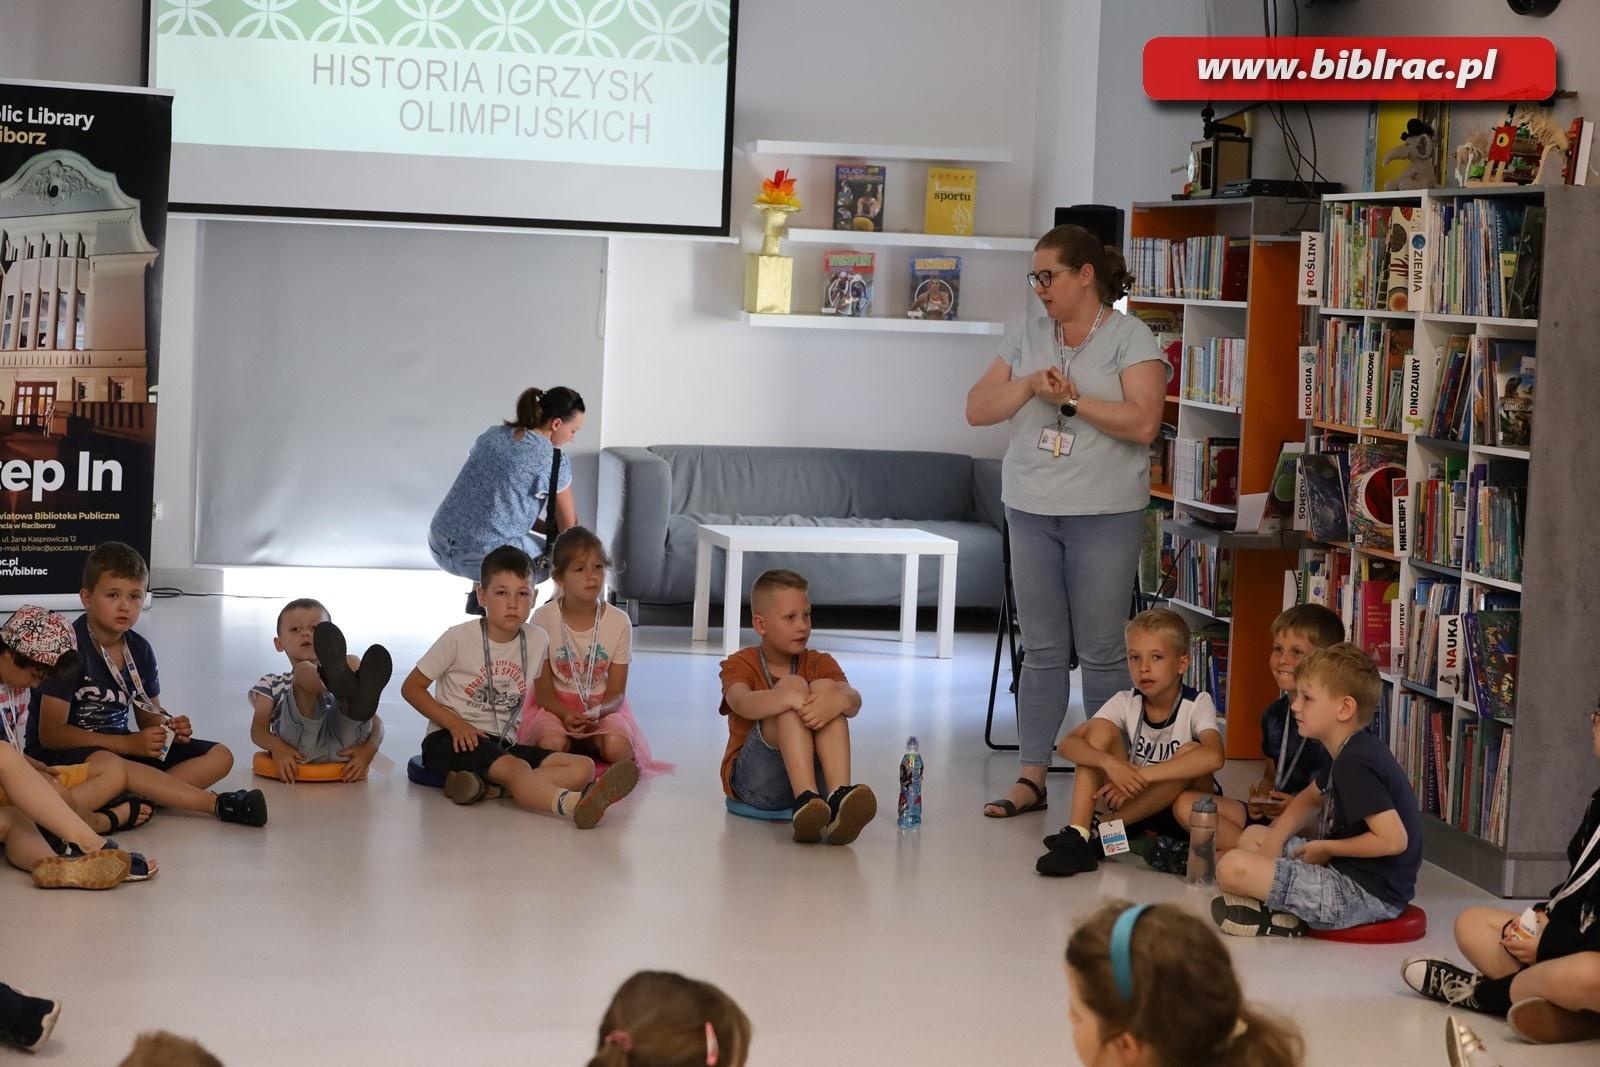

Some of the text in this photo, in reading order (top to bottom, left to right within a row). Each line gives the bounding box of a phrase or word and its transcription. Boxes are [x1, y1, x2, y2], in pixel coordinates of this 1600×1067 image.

[312, 53, 655, 104] HISTORIA IGRZYSK
[0, 104, 95, 131] lic Library
[399, 99, 651, 145] OLIMPIJSKICH
[934, 191, 972, 203] sportu
[1304, 235, 1317, 286] ROŚLINY
[1413, 250, 1423, 293] ZIEMIA
[1304, 367, 1313, 416] EKOLOGIA
[1365, 352, 1375, 418] PARKI NARODOWE
[1409, 358, 1421, 416] DINOZAURY
[0, 451, 123, 502] ep In
[28, 536, 69, 544] Kasprowicza
[34, 511, 77, 520] Biblioteka
[79, 512, 120, 520] Publiczna
[1398, 498, 1407, 551] MINECRAFT
[1446, 617, 1458, 668] NAUKA
[501, 667, 520, 681] SPEED
